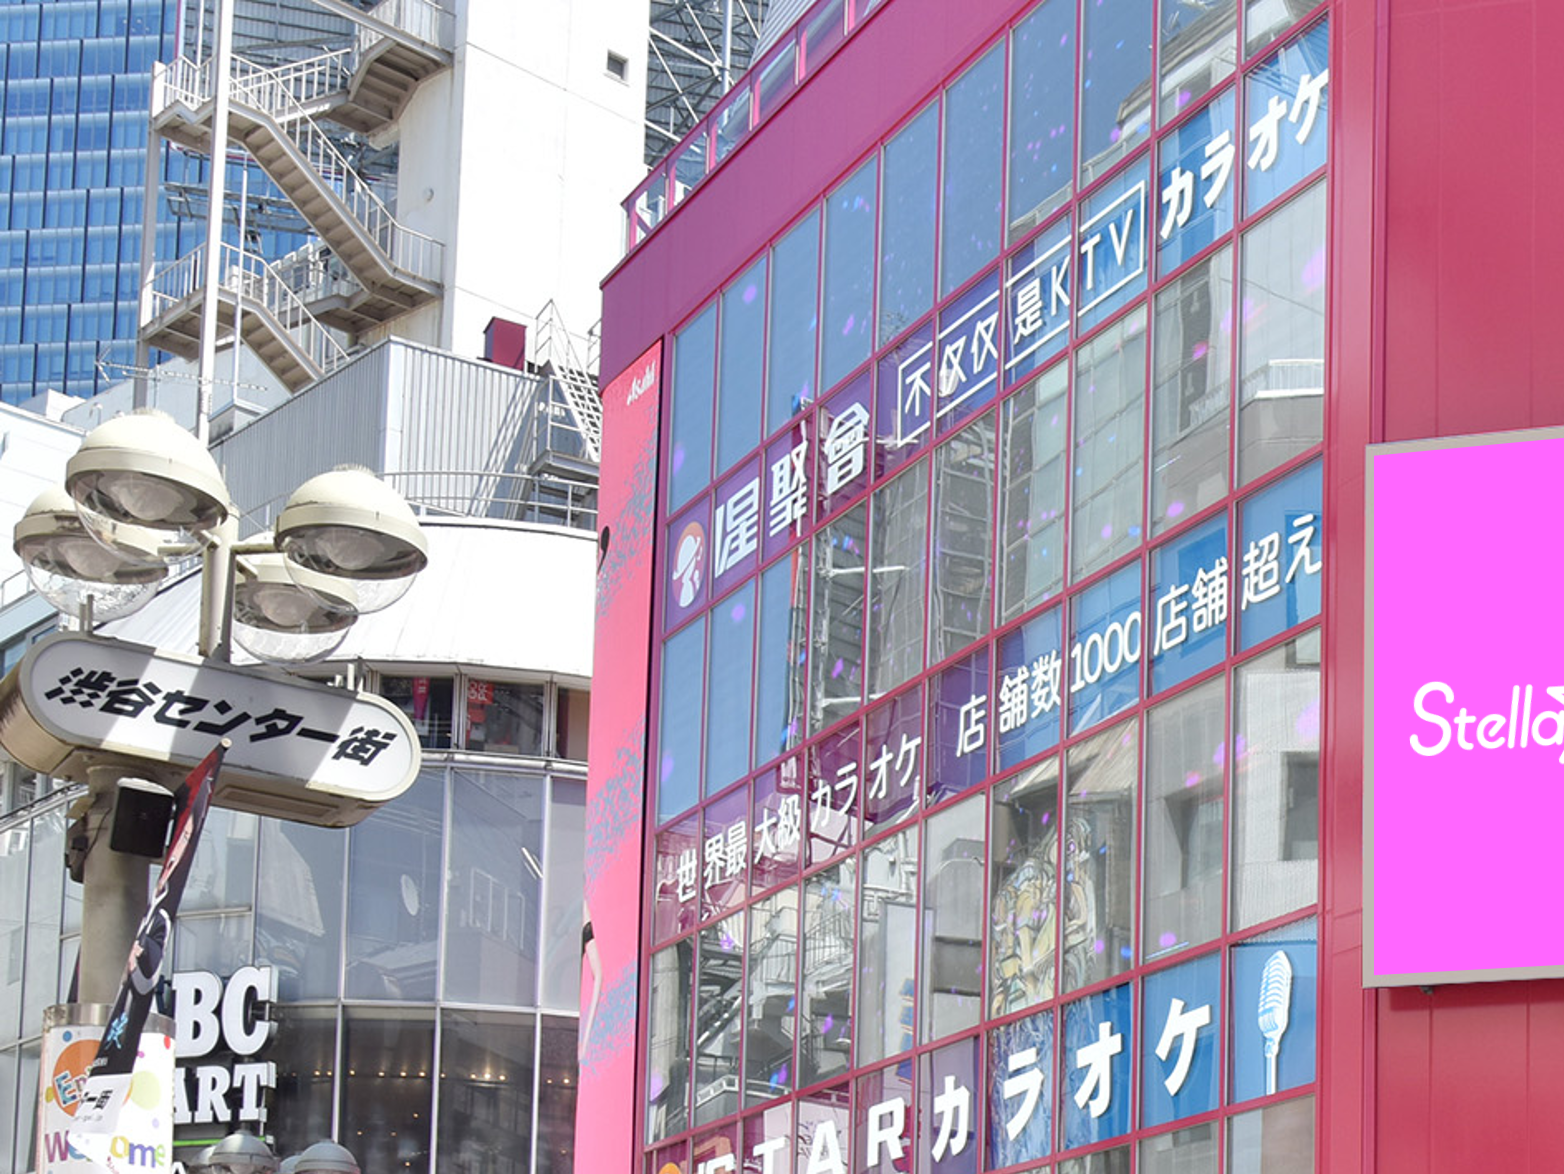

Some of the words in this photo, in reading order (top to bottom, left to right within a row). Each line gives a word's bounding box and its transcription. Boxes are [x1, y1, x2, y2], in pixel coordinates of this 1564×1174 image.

[1159, 69, 1329, 240] カラオケ
[45, 667, 398, 768] 渋谷センター街
[172, 965, 272, 1058] BC
[173, 1062, 268, 1125] ART
